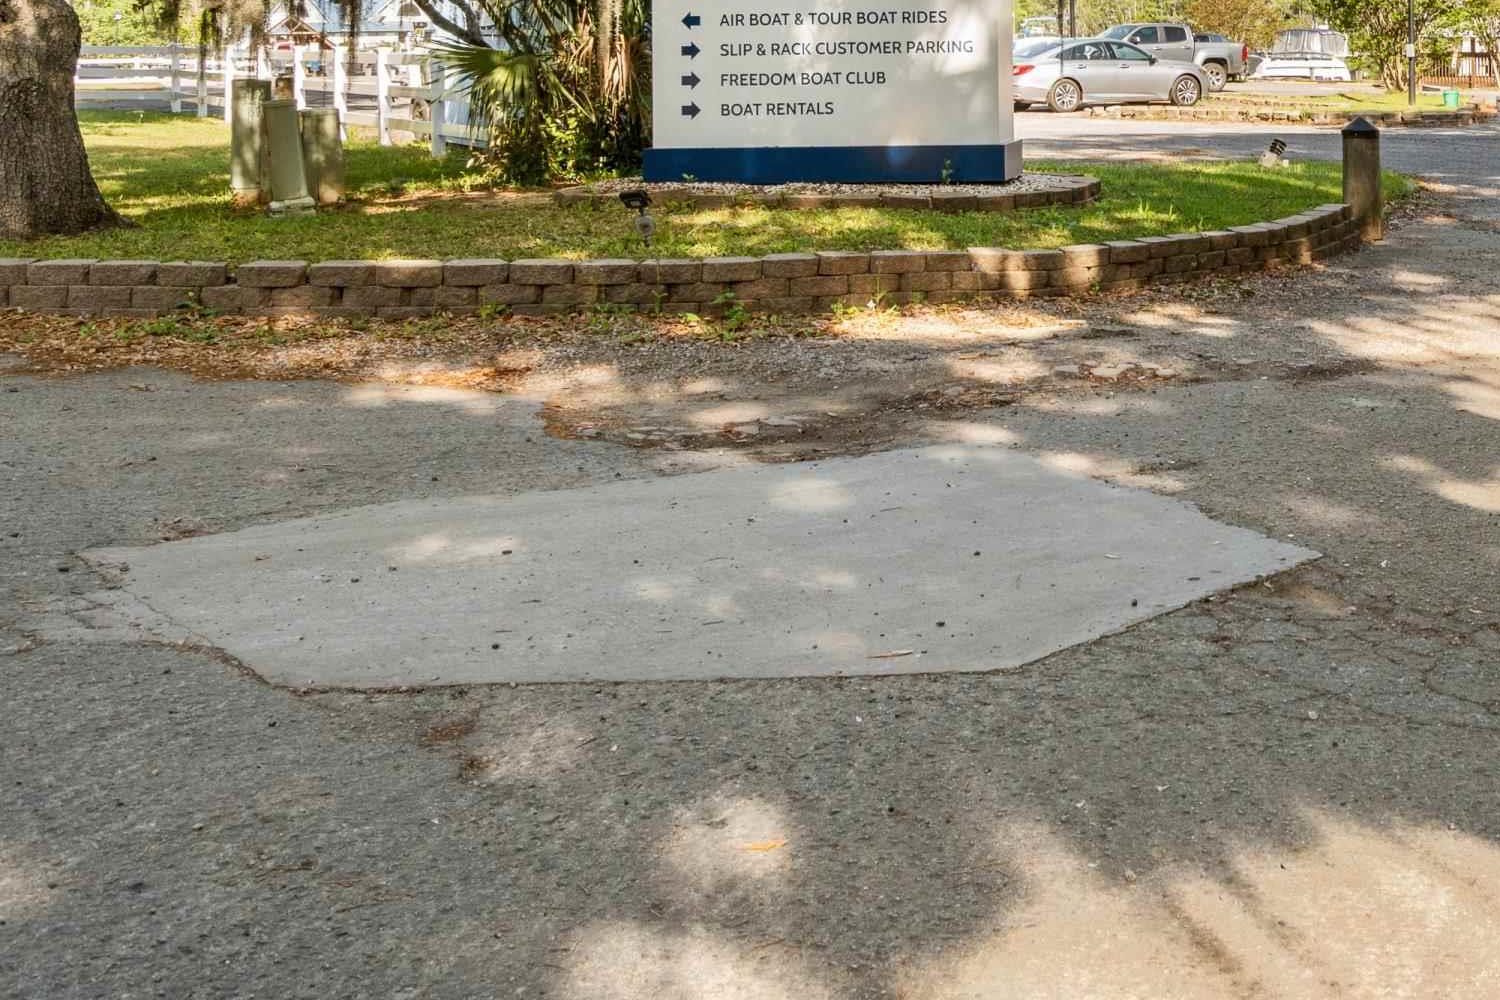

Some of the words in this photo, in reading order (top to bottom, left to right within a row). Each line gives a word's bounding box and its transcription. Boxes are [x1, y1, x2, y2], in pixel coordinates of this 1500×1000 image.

[719, 13, 745, 26] AIR
[750, 13, 790, 26] BOAT
[794, 12, 804, 25] &
[808, 12, 852, 25] TOUR
[856, 11, 898, 24] BOAT
[902, 10, 948, 24] RIDES
[720, 43, 753, 56] SLIP
[756, 43, 767, 56] &
[771, 42, 811, 56] RACK
[815, 41, 901, 55] CUSTOMER
[906, 40, 974, 54] PARKING
[720, 73, 796, 86] FREEDOM
[801, 72, 842, 85] BOAT
[846, 71, 886, 85] CLUB
[720, 103, 762, 116] BOAT
[766, 102, 834, 116] RENTALS
